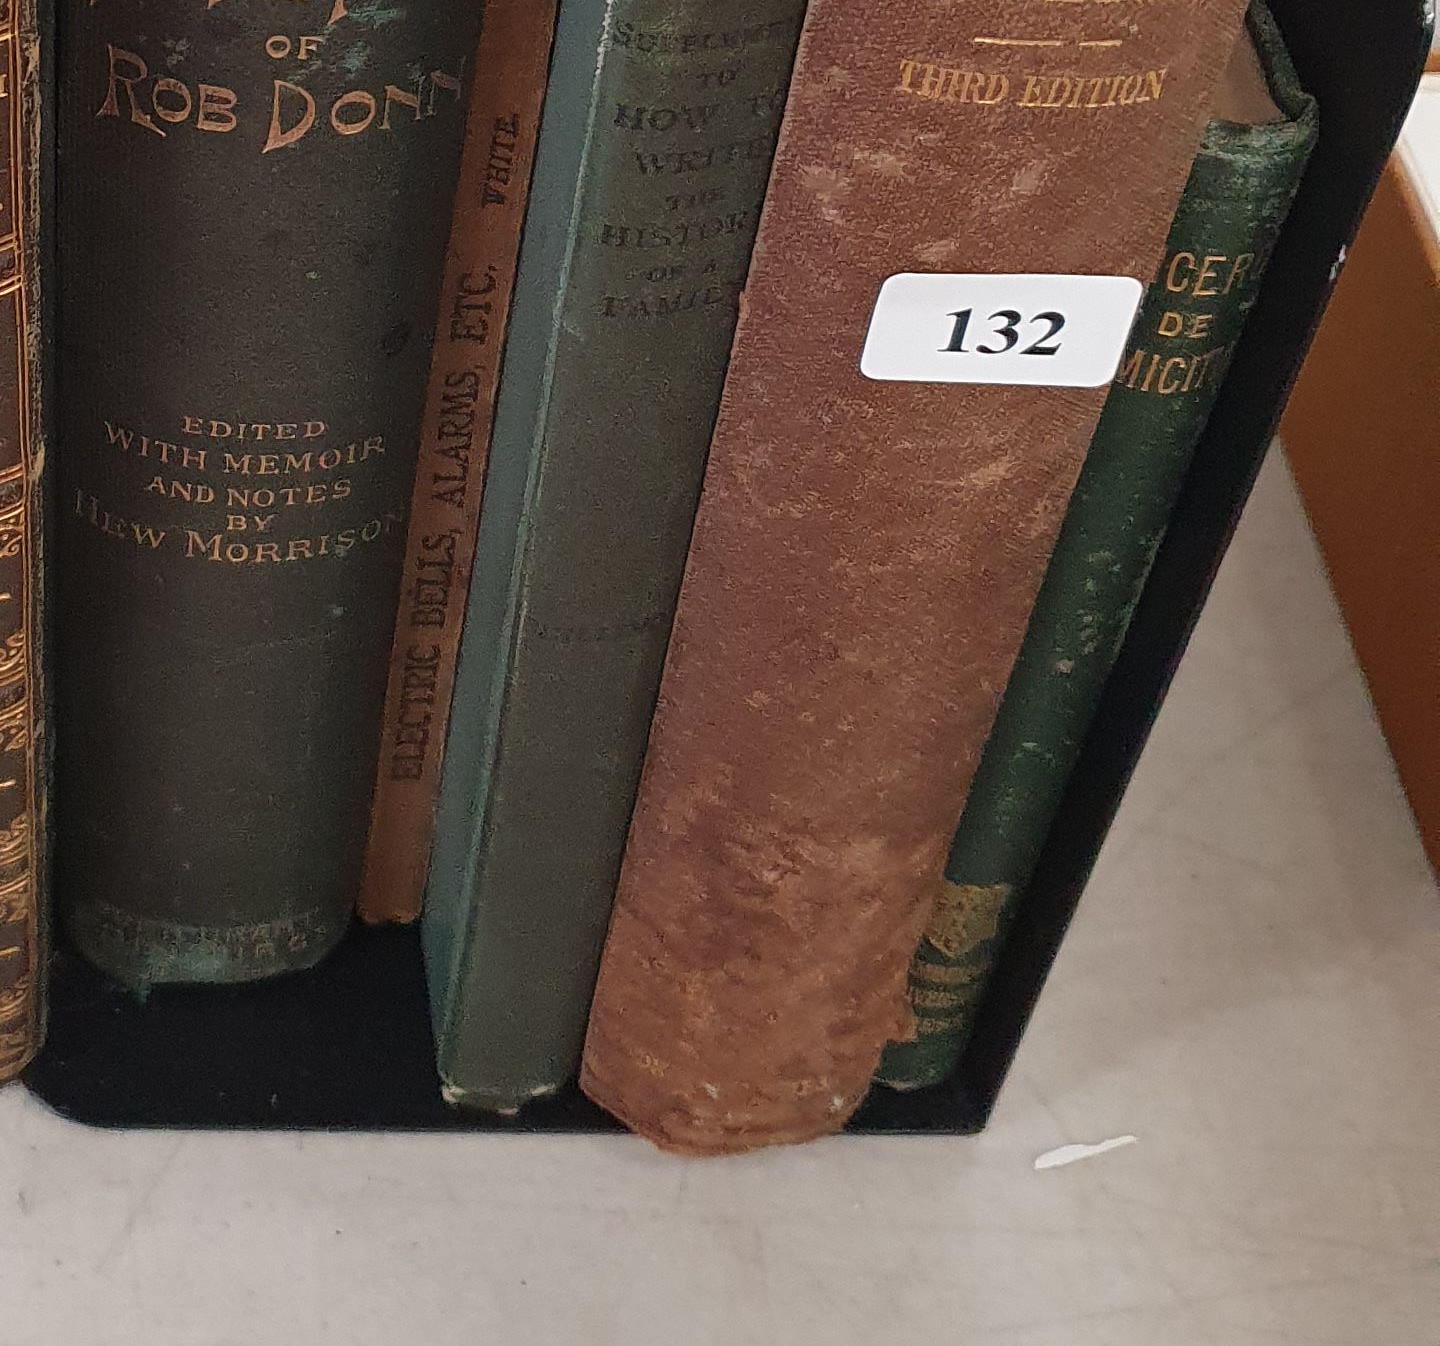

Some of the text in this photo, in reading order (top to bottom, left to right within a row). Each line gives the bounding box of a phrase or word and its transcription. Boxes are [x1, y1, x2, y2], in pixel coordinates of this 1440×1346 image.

[895, 60, 1167, 109] THIRD EDITION
[935, 307, 1067, 356] 132
[1158, 311, 1215, 339] DE
[181, 415, 328, 441] EDITED
[103, 420, 386, 476] WITH MEMOIR
[144, 475, 353, 508] AND NOTES
[226, 513, 278, 532] BY
